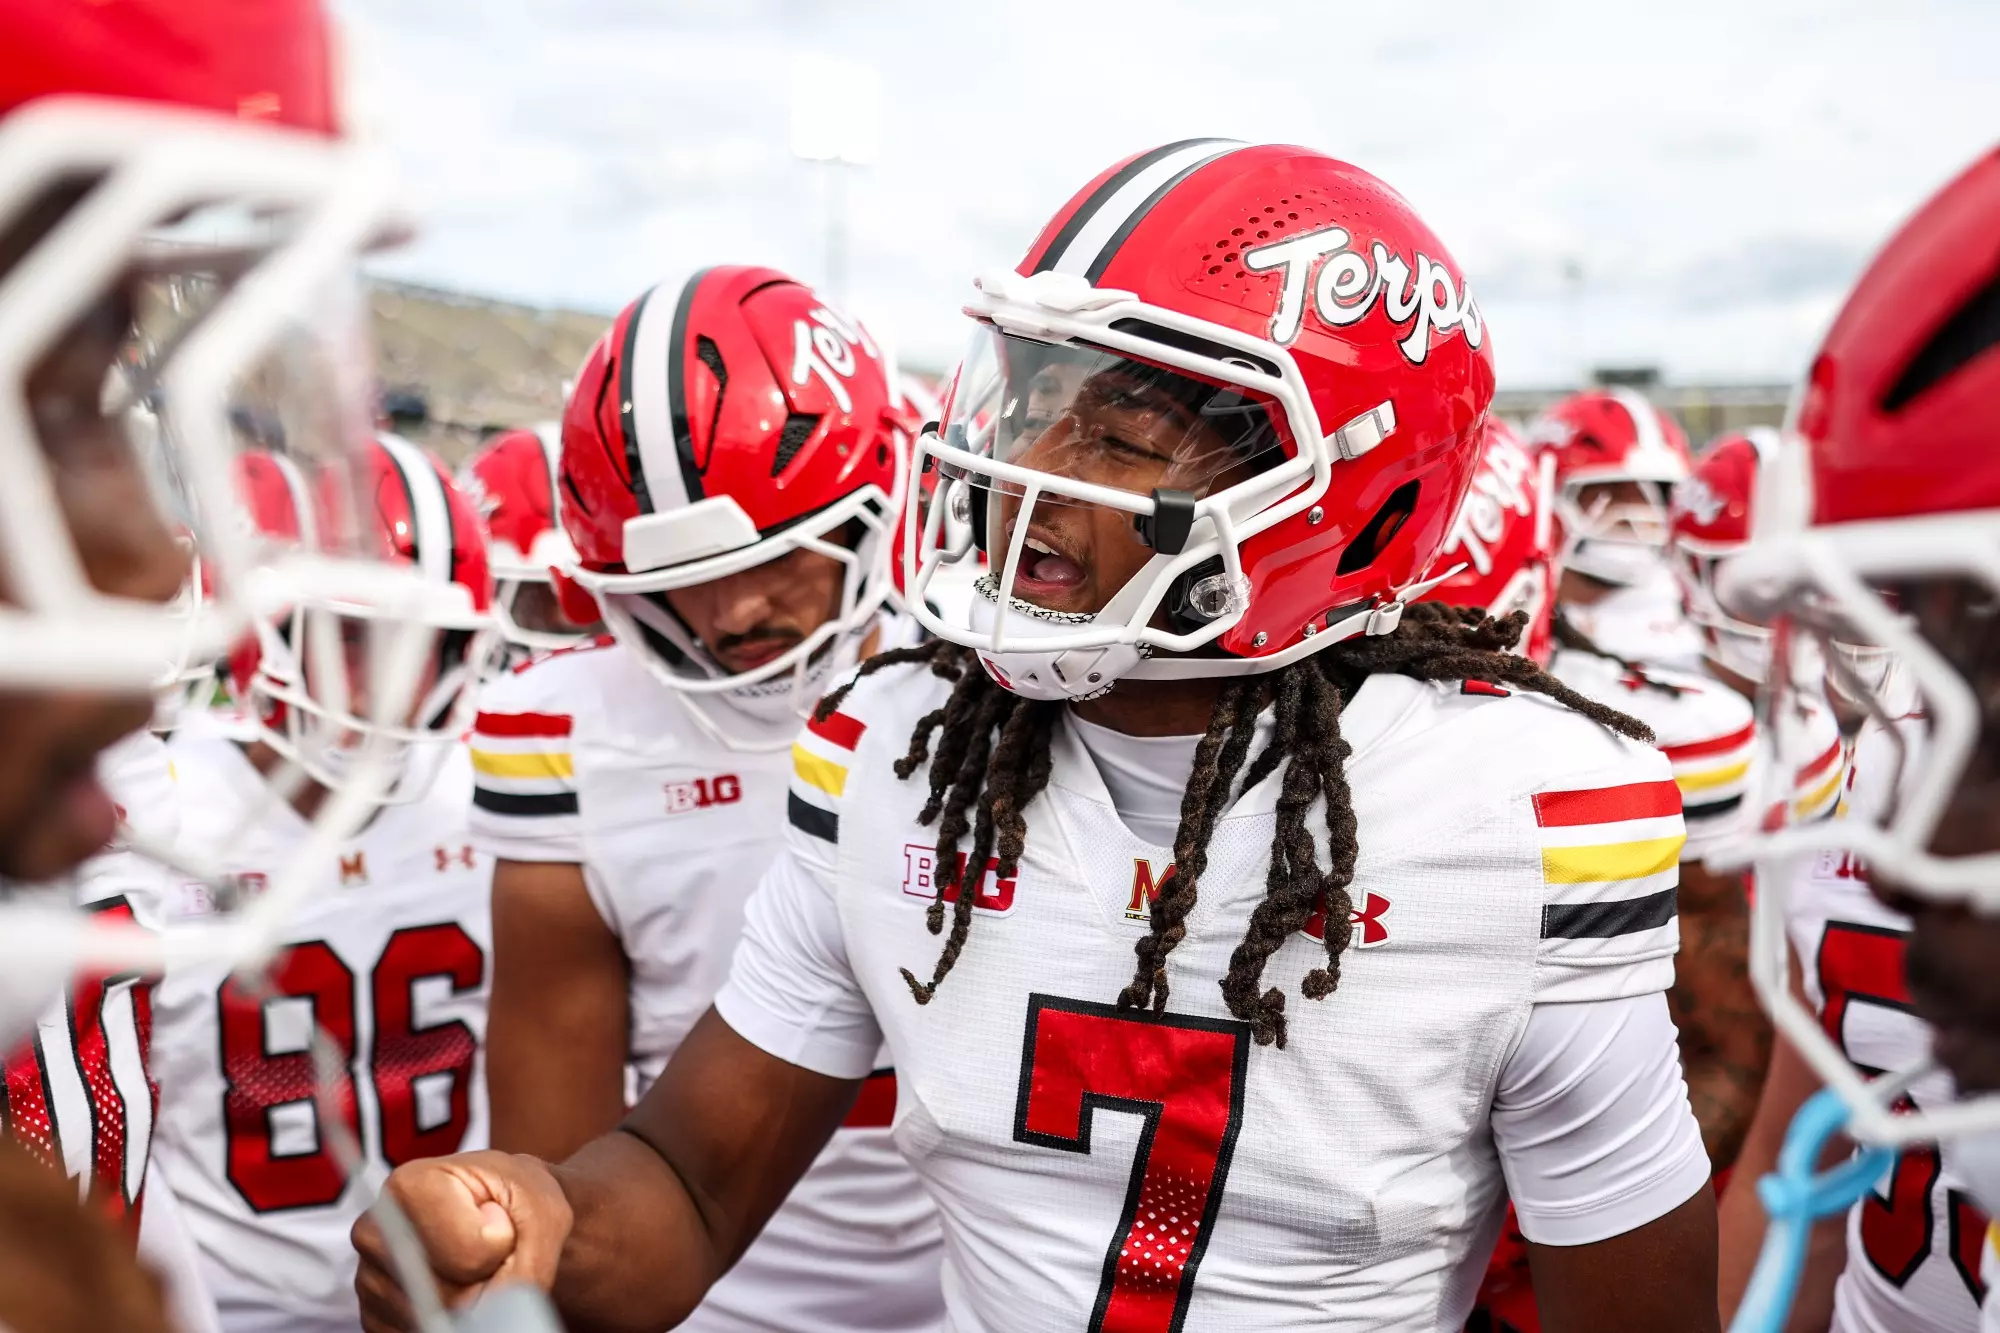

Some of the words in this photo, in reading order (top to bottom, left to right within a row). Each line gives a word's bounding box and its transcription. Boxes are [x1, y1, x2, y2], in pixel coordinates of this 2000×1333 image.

[1245, 227, 1483, 366] Terps
[218, 922, 483, 1214] 86
[1014, 993, 1250, 1333] 7
